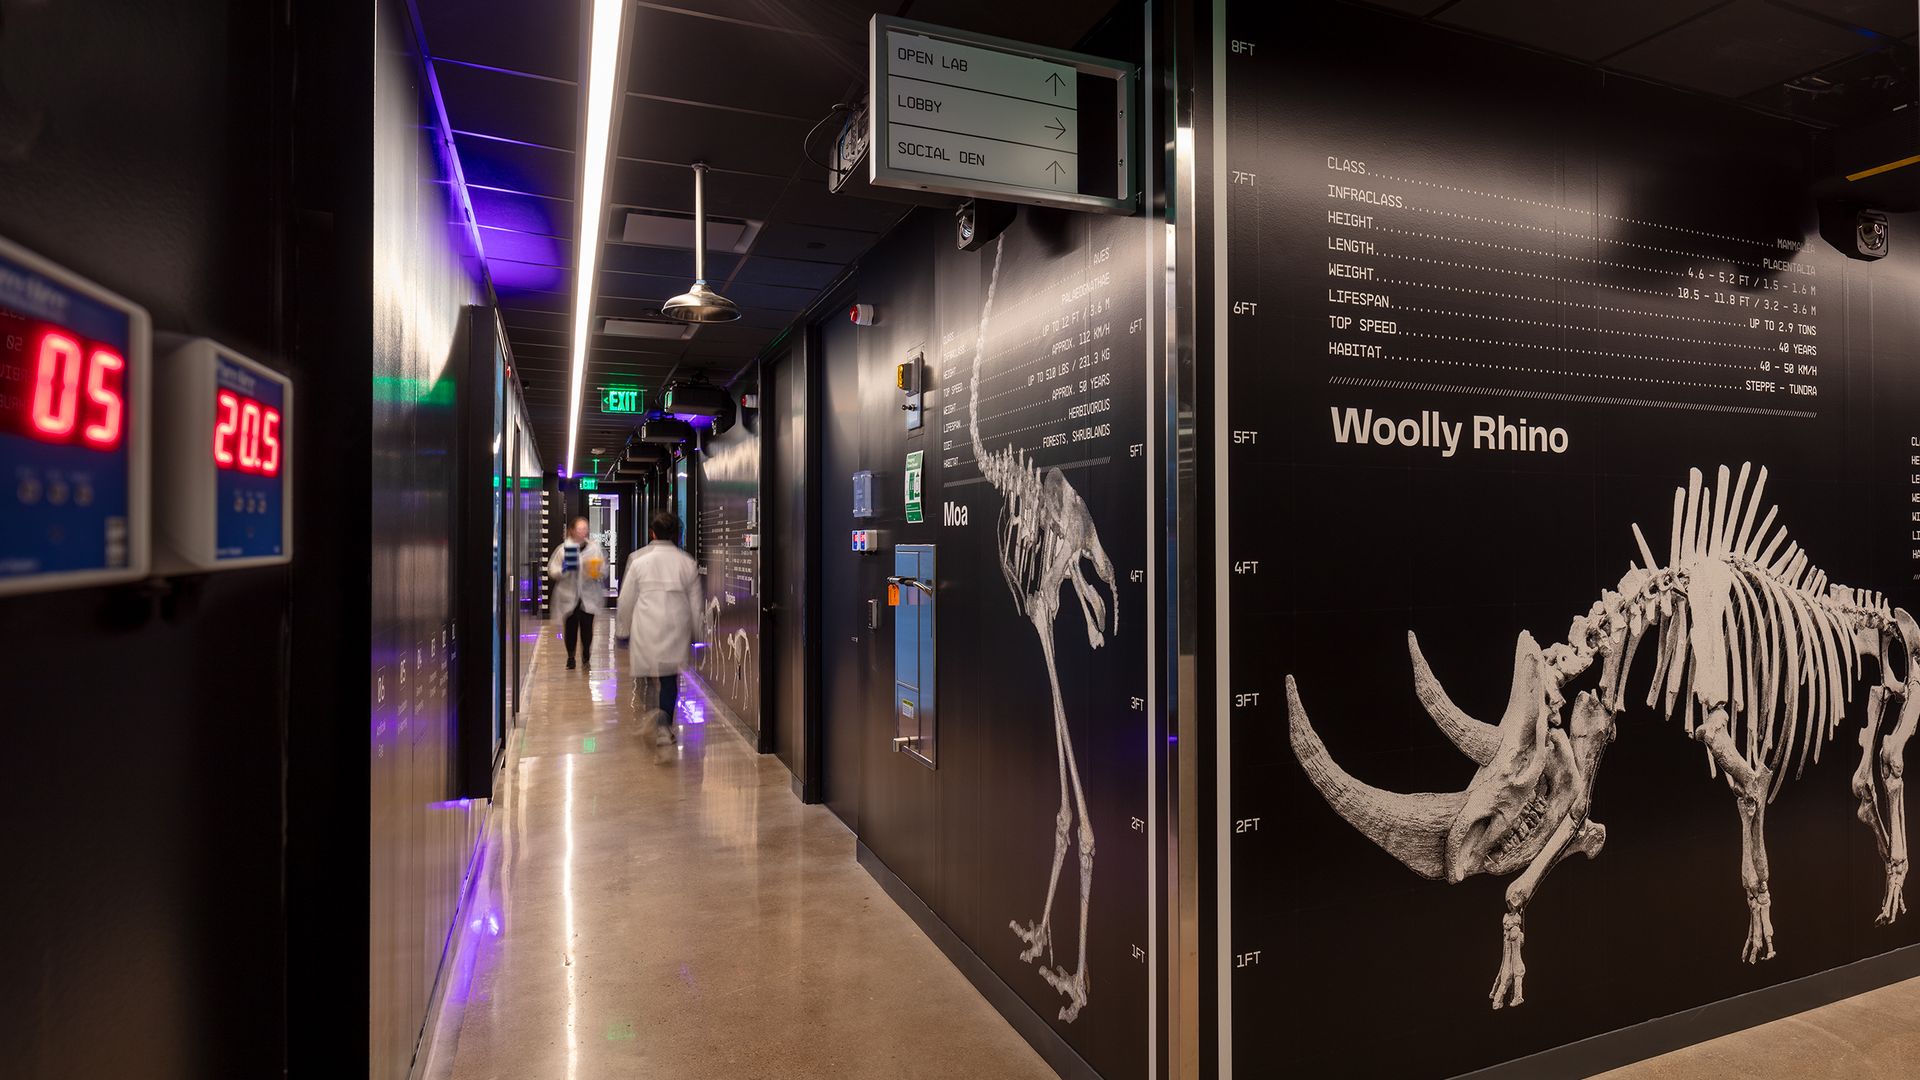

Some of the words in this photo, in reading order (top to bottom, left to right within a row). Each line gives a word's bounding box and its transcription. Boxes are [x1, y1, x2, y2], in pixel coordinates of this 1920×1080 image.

[1231, 40, 1256, 57] 8FT
[898, 47, 933, 66] OPEN
[942, 55, 968, 72] LAB
[898, 94, 942, 113] LOBBY
[898, 141, 950, 161] SOCIAL
[960, 151, 985, 167] DEN
[1327, 157, 1366, 174] CLASS
[1232, 171, 1256, 187] 7FT
[1328, 185, 1403, 208] INFRACLASS
[1763, 258, 1816, 276] PLACENTALIA
[1094, 247, 1110, 266] AVES
[1328, 211, 1374, 230] HEIGHT
[1688, 268, 1705, 280] 4.6
[1719, 272, 1735, 285] 5.2
[1739, 276, 1750, 287] FT
[1764, 278, 1780, 290] 1.5
[1792, 282, 1808, 294] 1.6
[1810, 287, 1816, 296] M
[1328, 237, 1374, 255] LENGTH
[1678, 288, 1700, 300] 10.5
[1714, 292, 1736, 305] 11.8
[1739, 296, 1750, 308] FT
[1764, 298, 1780, 311] 3.2
[1792, 302, 1808, 315] 3.6
[1811, 307, 1817, 316] M
[1233, 302, 1258, 316] 6FT
[1328, 263, 1374, 281] WEIGHT
[1750, 318, 1760, 329] UP
[1764, 321, 1775, 332] TO
[1778, 321, 1794, 334] 2.9
[1798, 324, 1817, 336] TONS
[1062, 315, 1070, 329] 12
[1072, 310, 1080, 324] FT
[1090, 301, 1102, 316] 3.6
[1328, 289, 1390, 308] LIFESPAN
[1778, 342, 1790, 354] 40
[1793, 344, 1817, 356] YEARS
[1079, 330, 1091, 346] 112
[1094, 323, 1110, 340] KM/H
[1129, 317, 1143, 336] 6FT
[1328, 316, 1352, 330] TOP
[1359, 318, 1397, 335] SPEED
[1760, 362, 1771, 373] 40
[1784, 363, 1794, 374] 50
[1798, 366, 1818, 376] KM/H
[1028, 374, 1035, 387] UP
[1037, 371, 1044, 383] TO
[1046, 367, 1056, 380] 510
[1058, 362, 1070, 376] LBS
[1079, 352, 1100, 370] 231.3
[1102, 348, 1110, 362] KG
[1328, 342, 1382, 359] HABITAT
[1746, 380, 1776, 394] STEPPE
[1789, 384, 1818, 396] TUNDRA
[33, 333, 125, 446] 05
[1052, 384, 1076, 401] APPROX.
[1079, 380, 1088, 393] 50
[1090, 373, 1110, 390] YEARS
[609, 391, 637, 412] EXIT
[1068, 398, 1111, 420] HERBIVOROUS
[213, 390, 280, 476] 20.5
[1042, 432, 1069, 448] FORESTS,
[1072, 423, 1111, 442] SHRUBLANDS
[1232, 430, 1258, 445] 5FT
[1331, 406, 1463, 458] Woolly
[1473, 415, 1569, 454] Rhino
[1911, 436, 1920, 447] CL
[1129, 444, 1143, 458] 5FT
[943, 500, 968, 527] Moa
[1130, 569, 1144, 584] 4FT
[1234, 561, 1258, 575] 4FT
[1130, 696, 1144, 712] 3FT
[1235, 693, 1260, 708] 3FT
[1131, 816, 1145, 834] 2FT
[1236, 818, 1260, 834] 2FT
[1131, 944, 1146, 964] 1FT
[1236, 951, 1261, 968] 1FT
